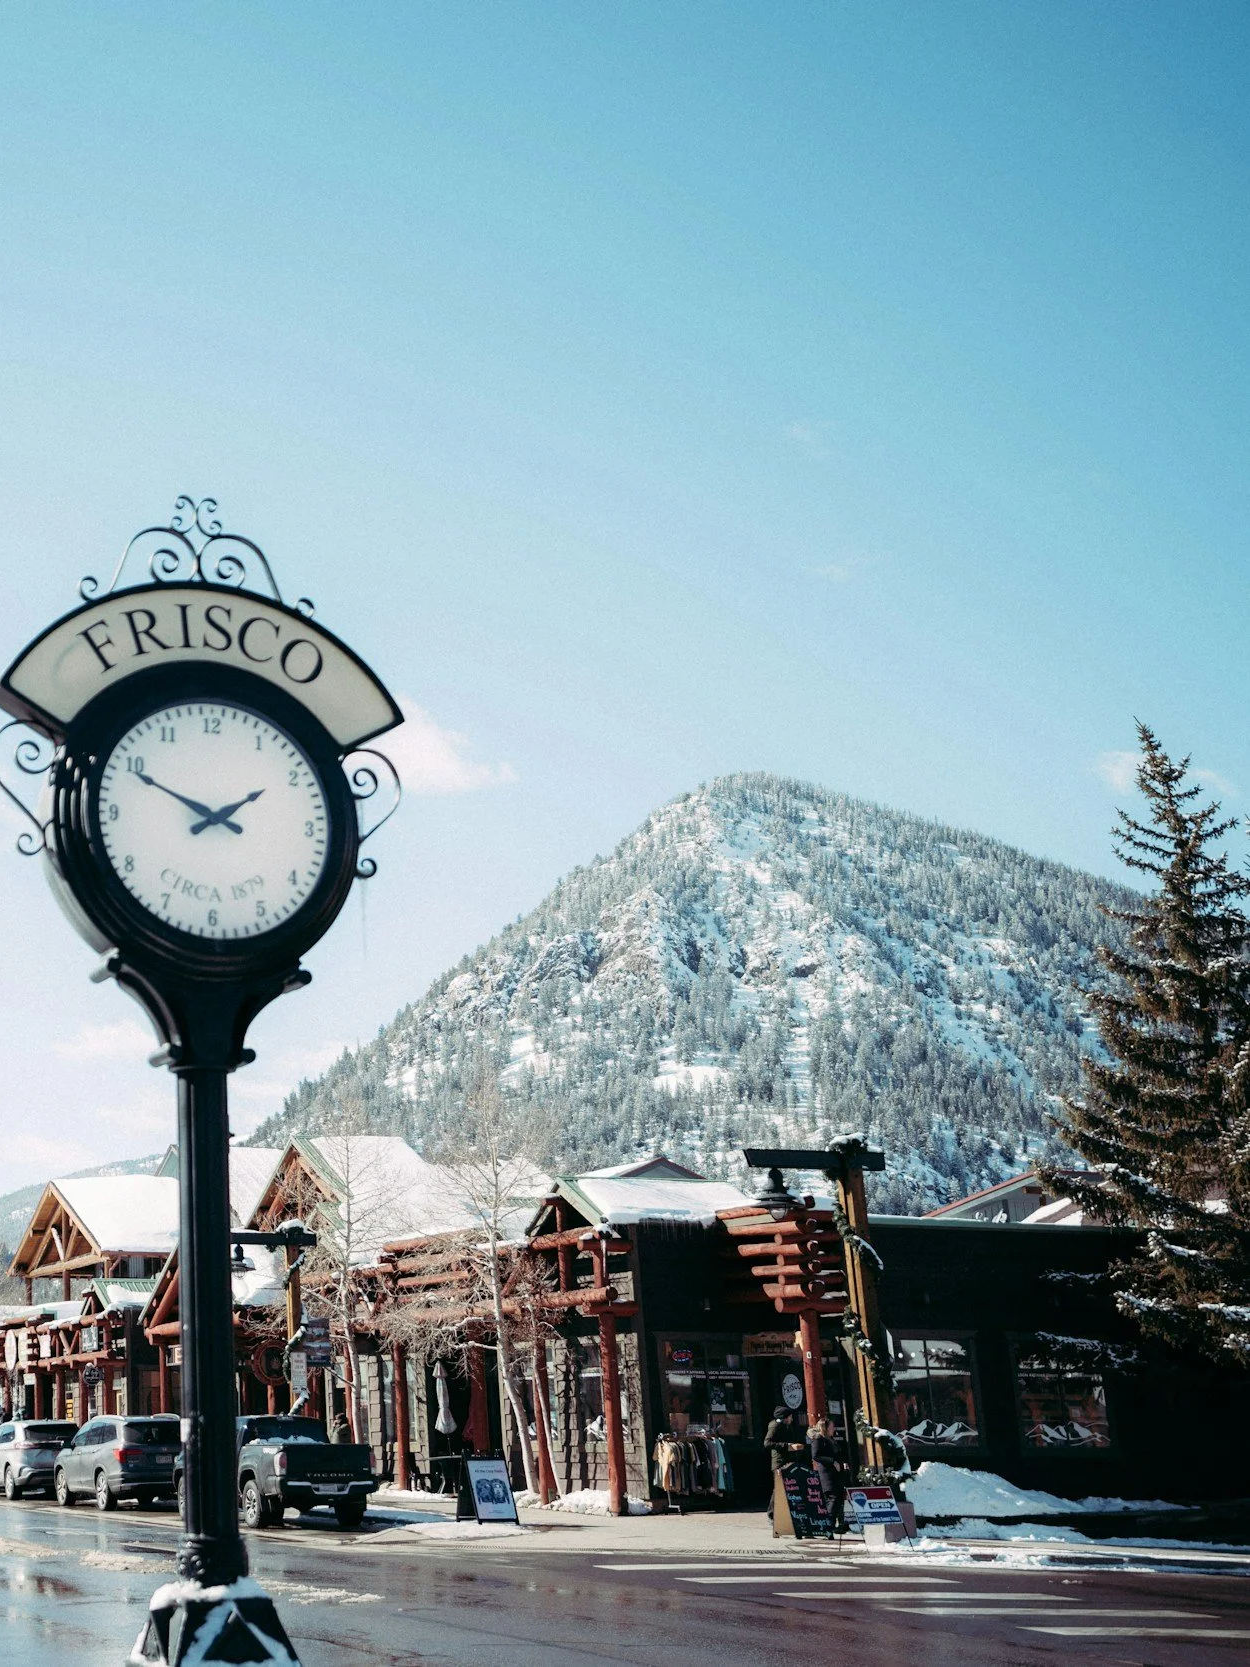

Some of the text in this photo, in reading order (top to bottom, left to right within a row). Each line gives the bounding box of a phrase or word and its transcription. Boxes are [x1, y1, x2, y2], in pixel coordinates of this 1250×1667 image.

[77, 603, 324, 683] FRISCO
[203, 717, 221, 734] 12
[160, 726, 176, 743] 11
[255, 735, 262, 750] 1
[126, 756, 144, 773] 10
[288, 770, 299, 786] 2
[109, 804, 119, 821] 9
[304, 821, 314, 837] 3
[124, 855, 134, 872] 8
[160, 868, 264, 902] CIRCA 1879
[288, 870, 297, 885] 4
[161, 893, 171, 910] 7
[256, 901, 265, 917] 5
[207, 909, 217, 926] 6
[672, 1351, 693, 1360] OPEN
